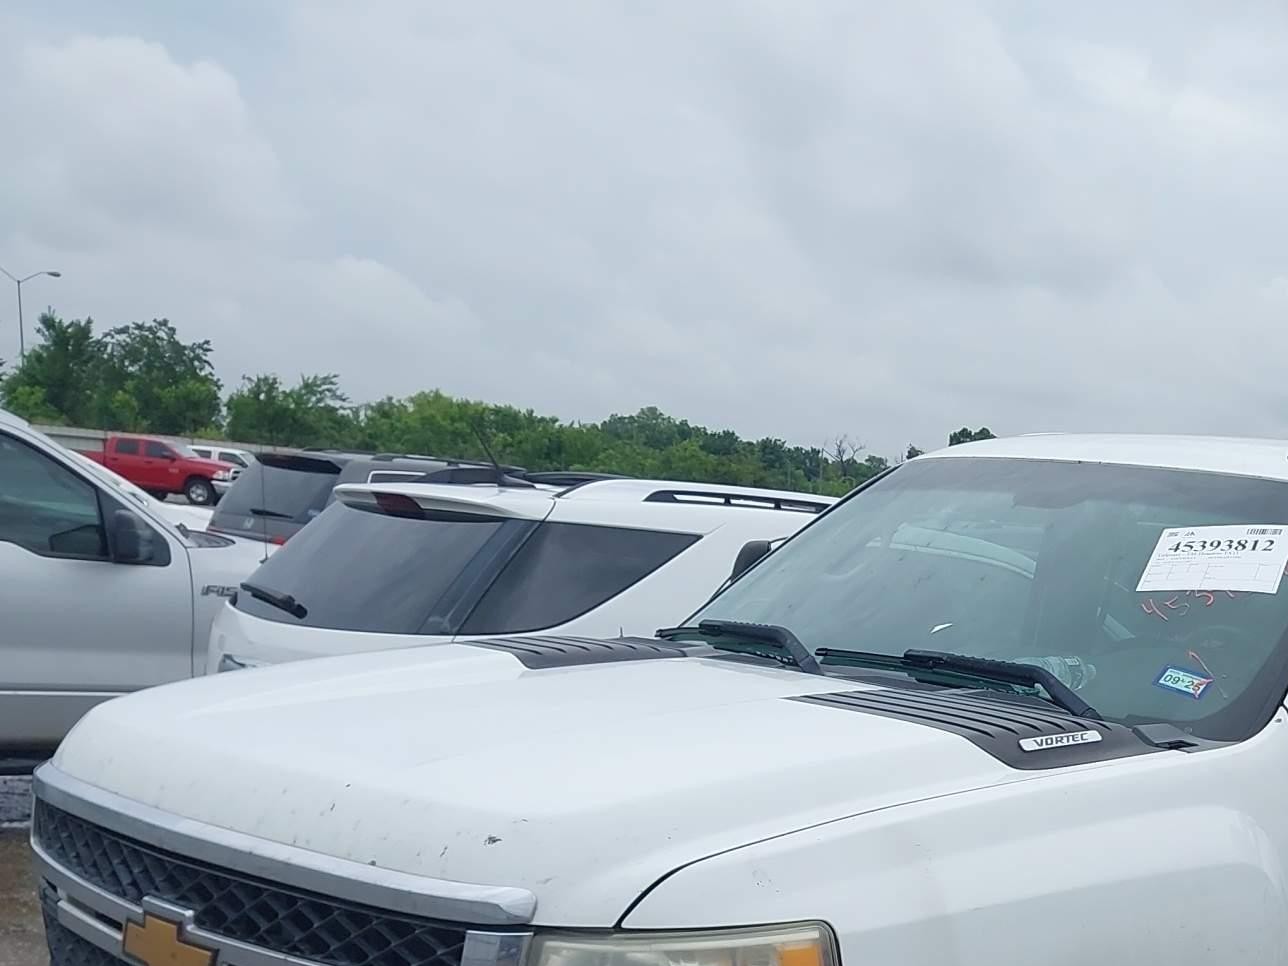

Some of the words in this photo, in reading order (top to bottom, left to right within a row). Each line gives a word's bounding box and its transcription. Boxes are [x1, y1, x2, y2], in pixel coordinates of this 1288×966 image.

[1168, 539, 1275, 553] 45393812
[1163, 674, 1181, 685] 09
[1184, 680, 1201, 692] 25
[1033, 733, 1089, 747] VORTEC
